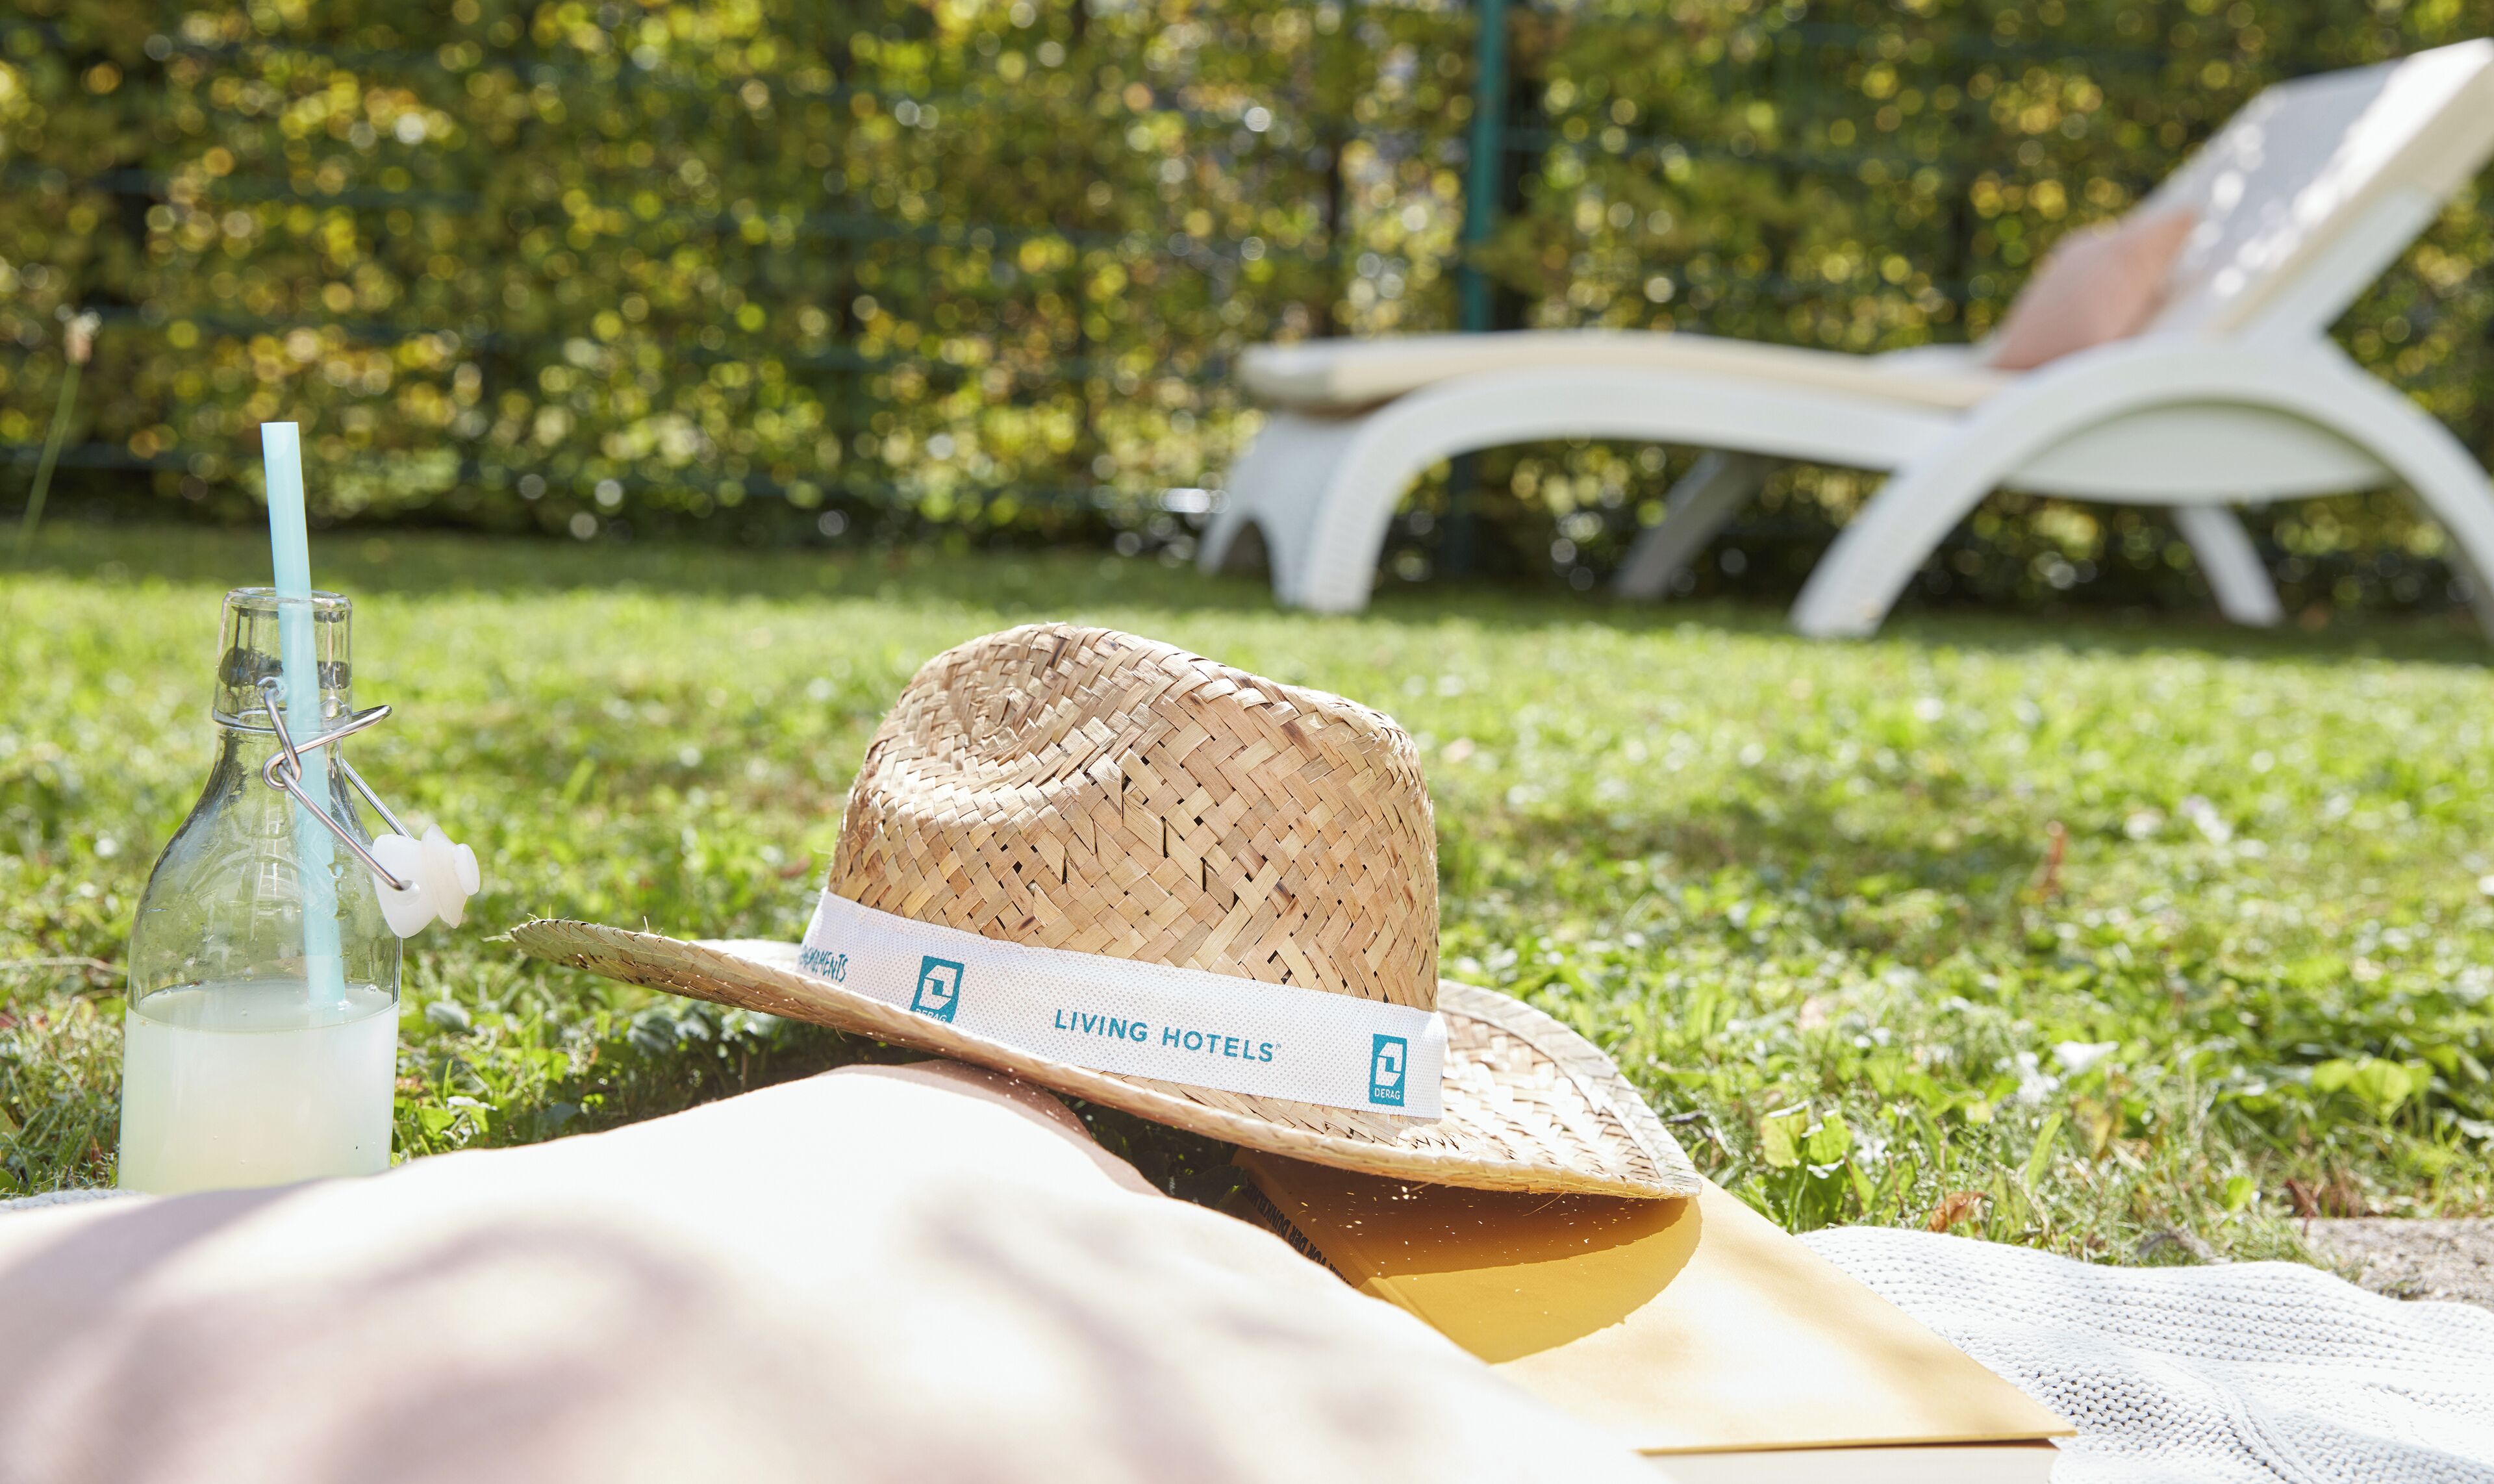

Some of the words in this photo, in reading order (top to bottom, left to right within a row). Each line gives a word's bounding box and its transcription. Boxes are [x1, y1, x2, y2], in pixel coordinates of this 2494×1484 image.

[1055, 1009, 1148, 1042] LIVING
[1374, 1087, 1401, 1100] DERAG
[1288, 1225, 1309, 1255] DER
